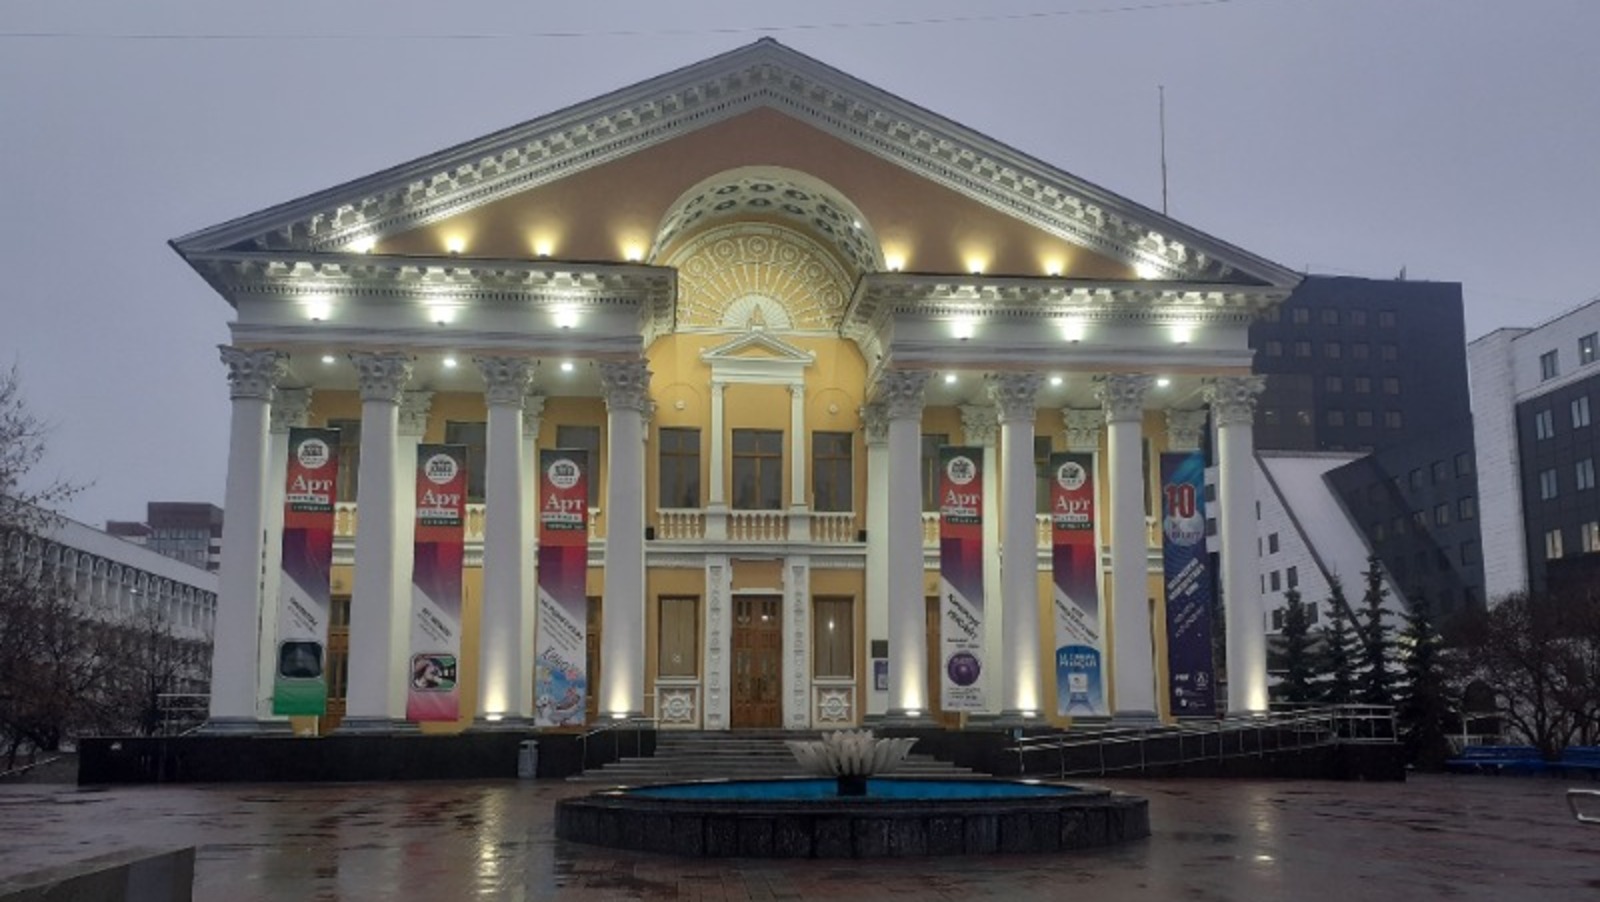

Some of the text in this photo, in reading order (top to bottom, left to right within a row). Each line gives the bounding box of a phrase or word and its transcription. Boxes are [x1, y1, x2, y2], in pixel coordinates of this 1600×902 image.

[292, 475, 332, 493] Арт
[421, 489, 460, 508] Арт
[545, 493, 584, 512] Арт
[945, 489, 980, 508] Арт
[1056, 495, 1091, 513] Арт
[1164, 483, 1196, 518] 10
